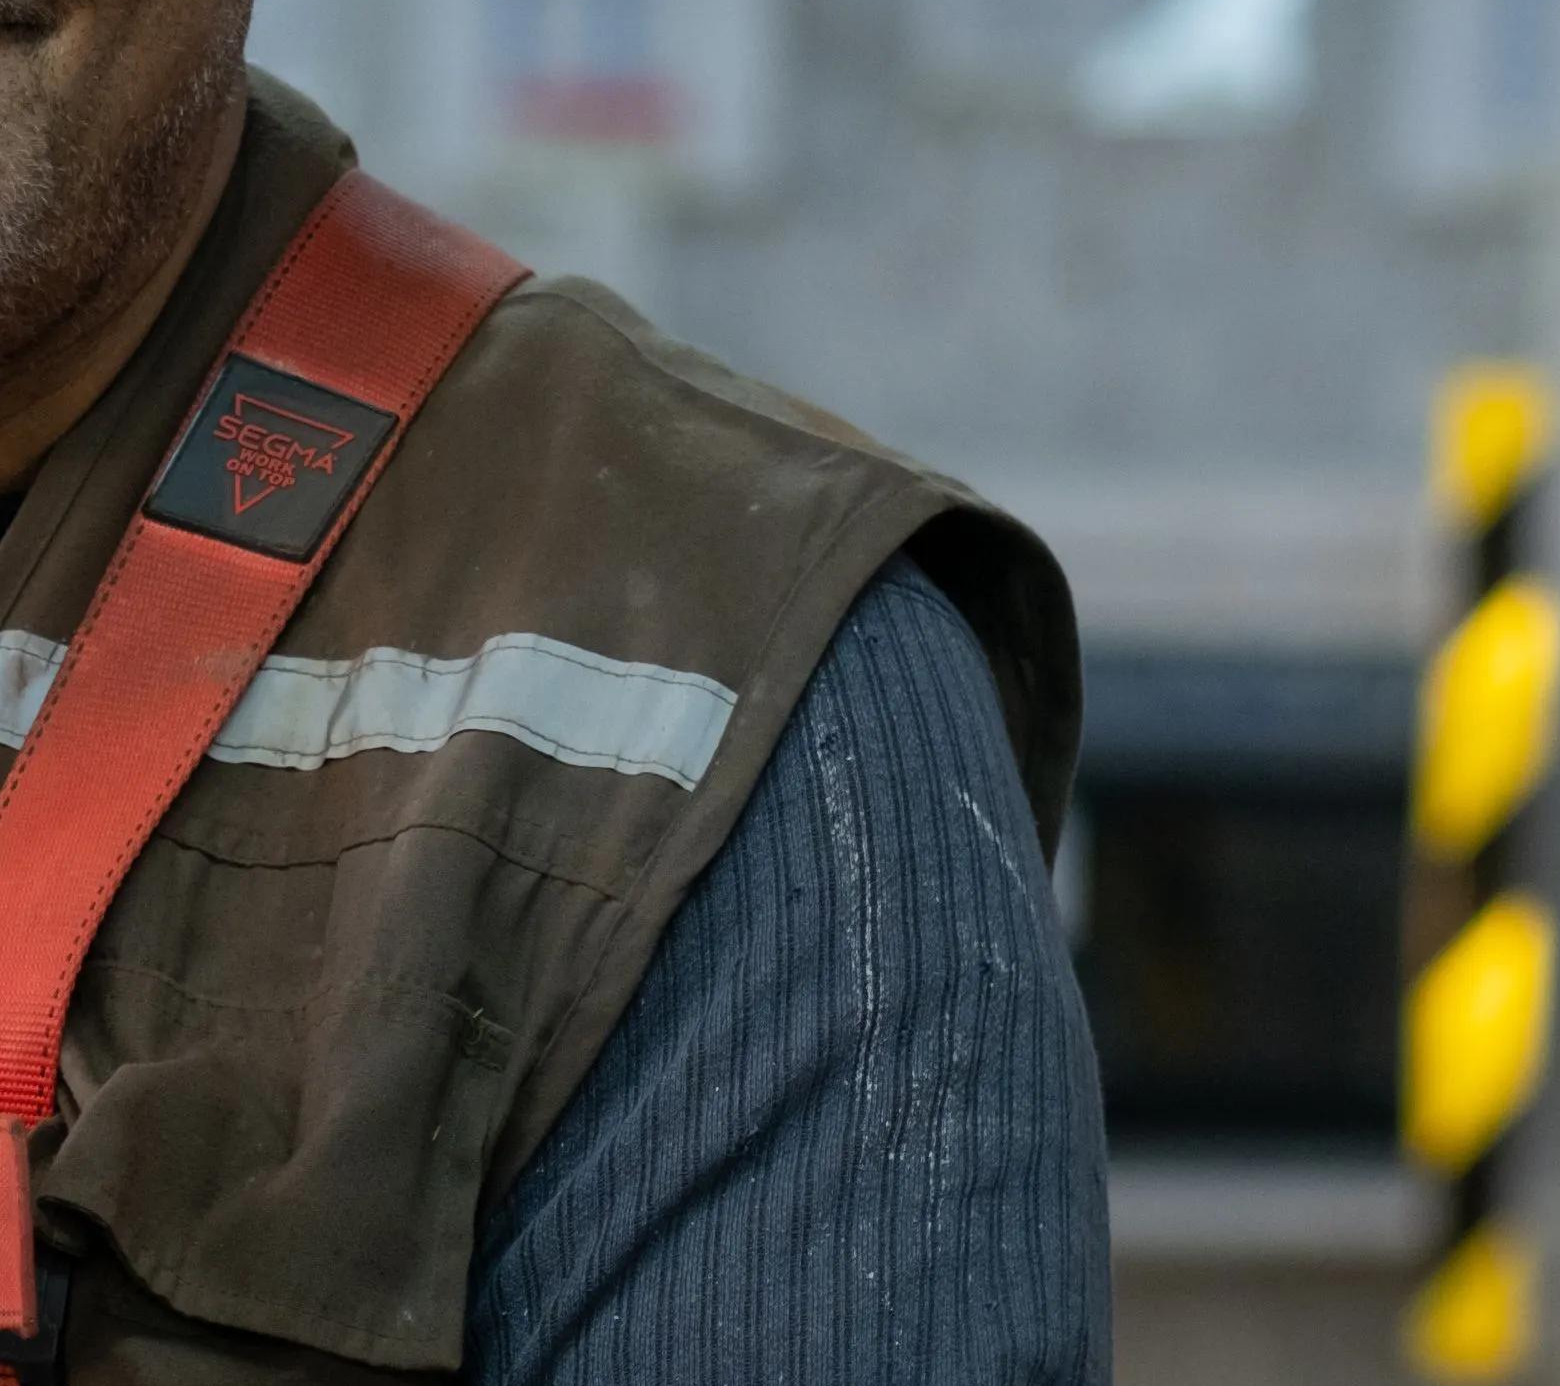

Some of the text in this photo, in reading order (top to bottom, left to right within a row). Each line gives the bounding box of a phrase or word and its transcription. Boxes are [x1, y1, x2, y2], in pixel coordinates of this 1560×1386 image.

[213, 415, 335, 475] SEGMA
[226, 458, 296, 488] ON TOP
[240, 447, 295, 476] WORK
